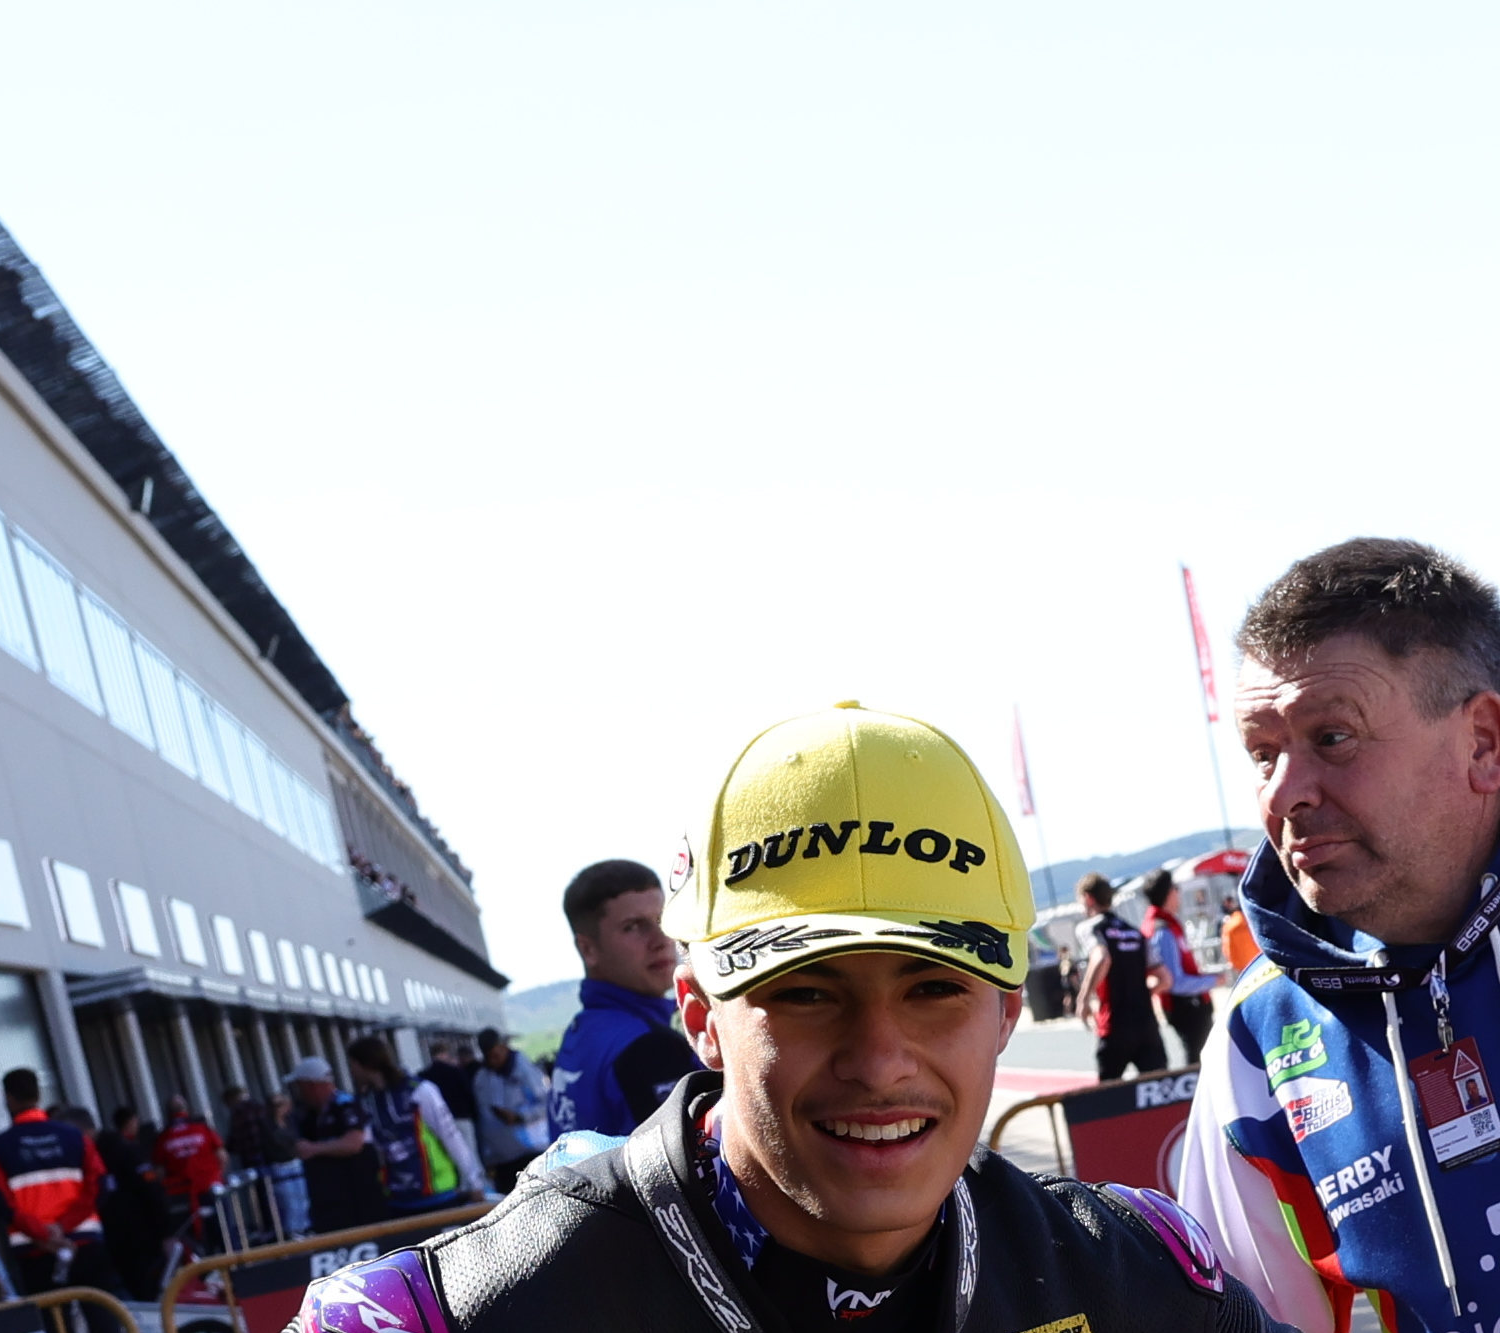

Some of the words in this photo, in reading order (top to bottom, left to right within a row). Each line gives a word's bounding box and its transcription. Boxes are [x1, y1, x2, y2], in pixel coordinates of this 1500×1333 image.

[726, 821, 985, 886] DUNLOP
[1457, 914, 1489, 952] BSB
[1328, 1173, 1405, 1231] wasaki
